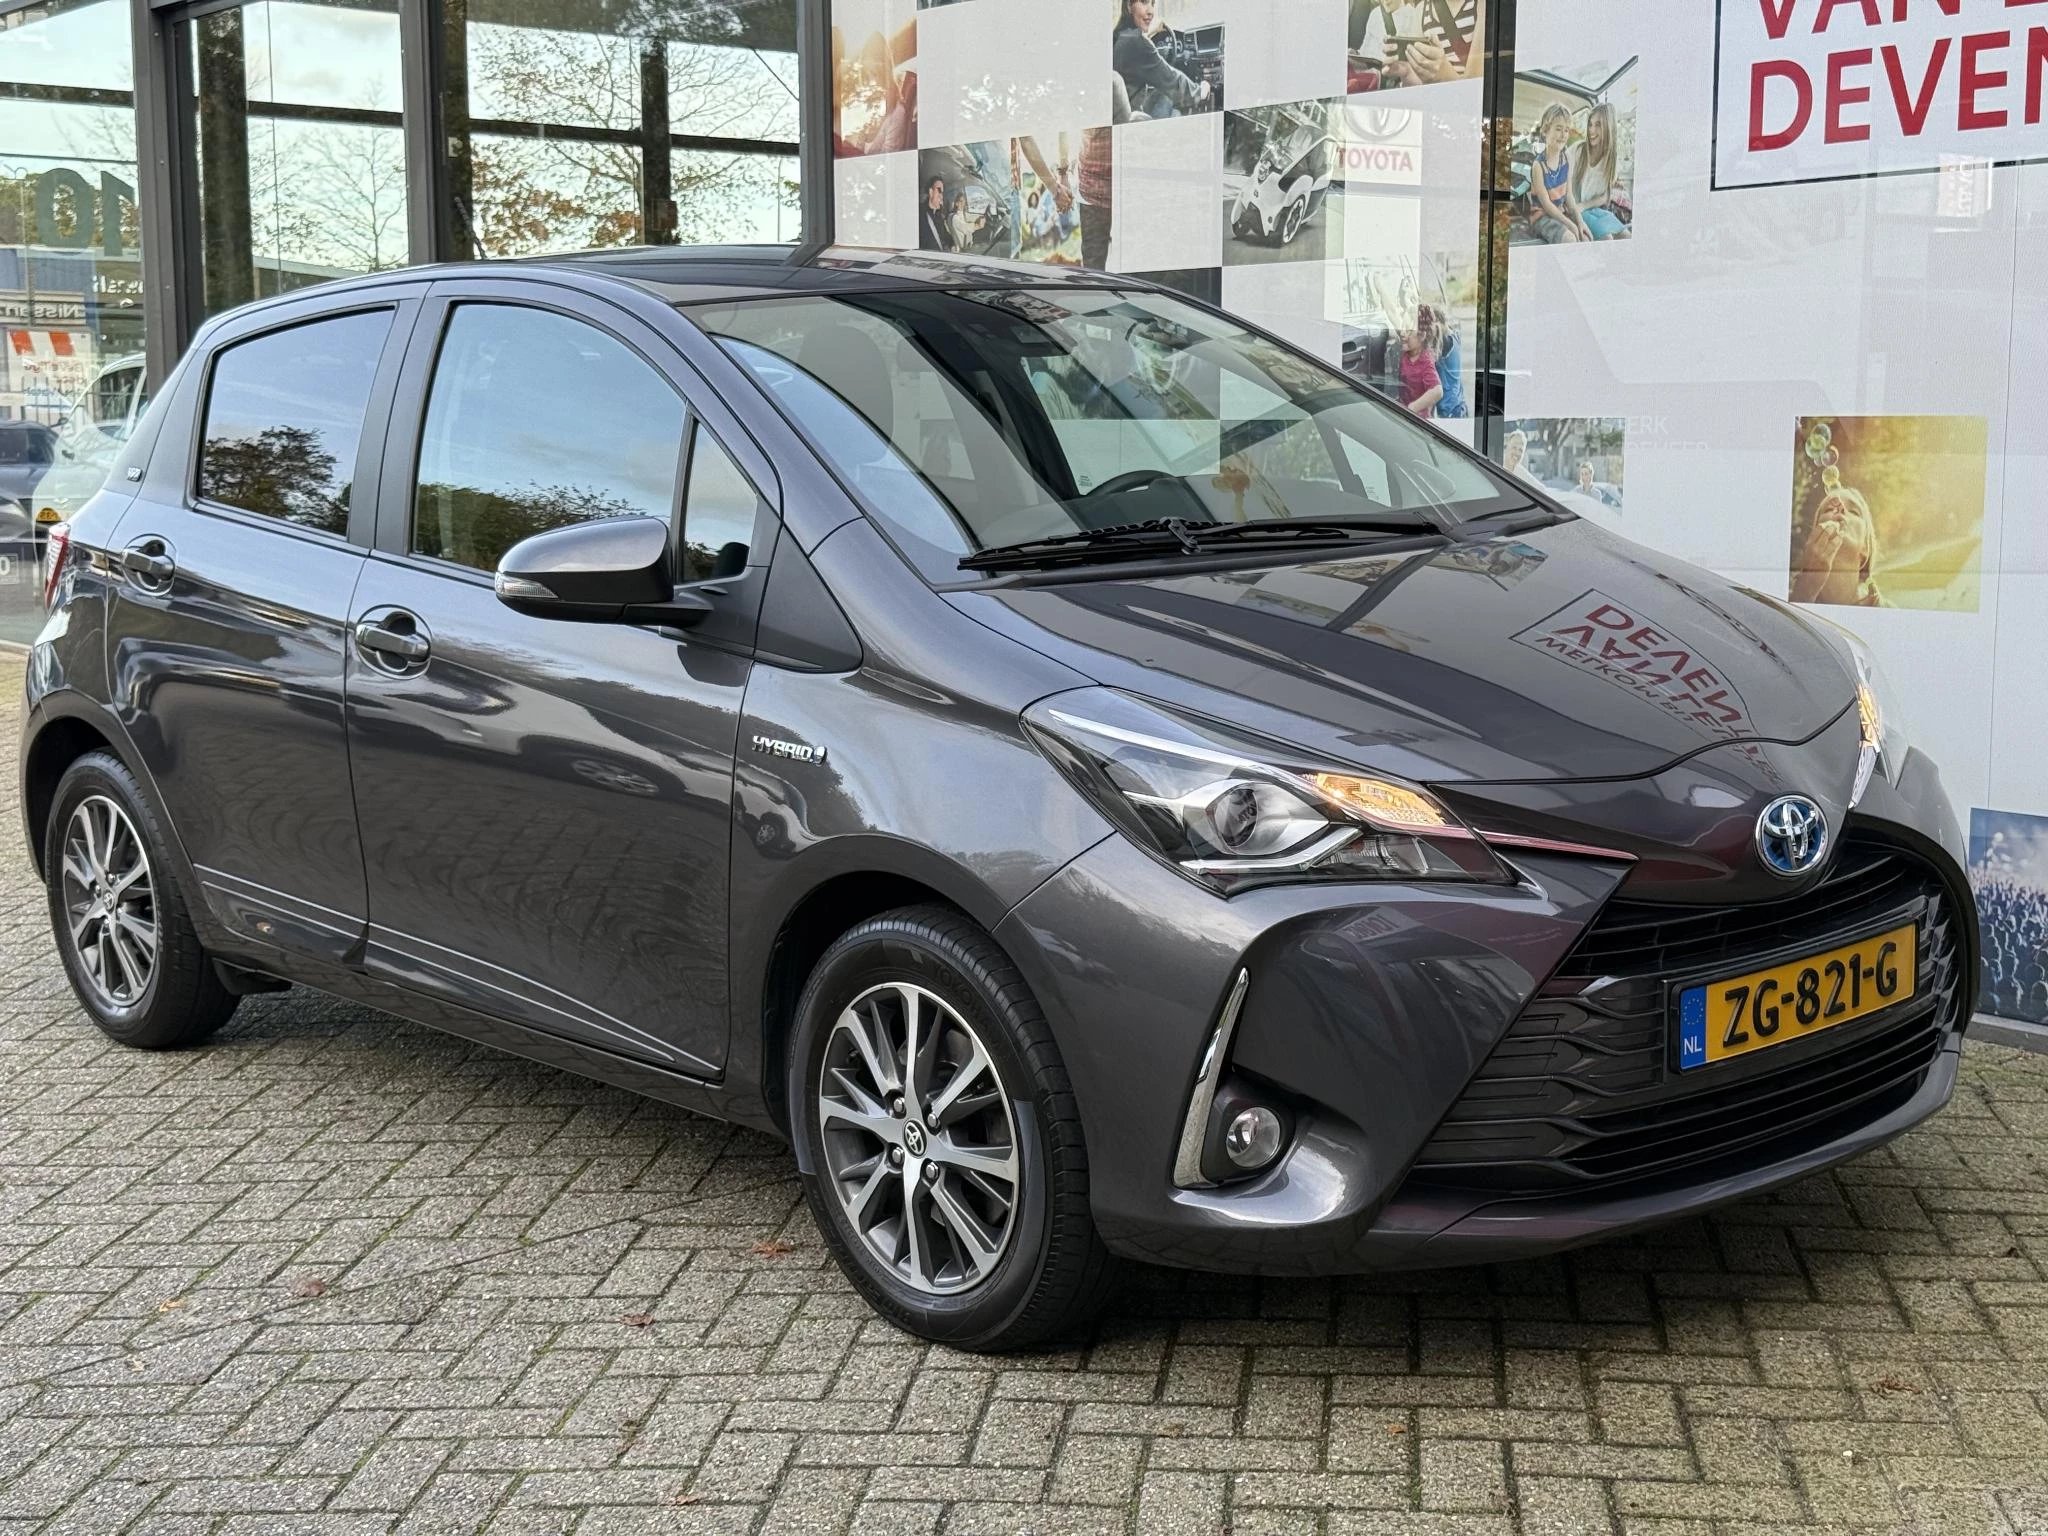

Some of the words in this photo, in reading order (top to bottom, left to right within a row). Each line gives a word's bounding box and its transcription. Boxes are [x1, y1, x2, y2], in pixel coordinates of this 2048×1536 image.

[1336, 147, 1413, 172] TOYOTA
[751, 735, 814, 762] HYBRID
[1722, 941, 1898, 1049] ZG-821-G
[1683, 1036, 1703, 1055] NL
